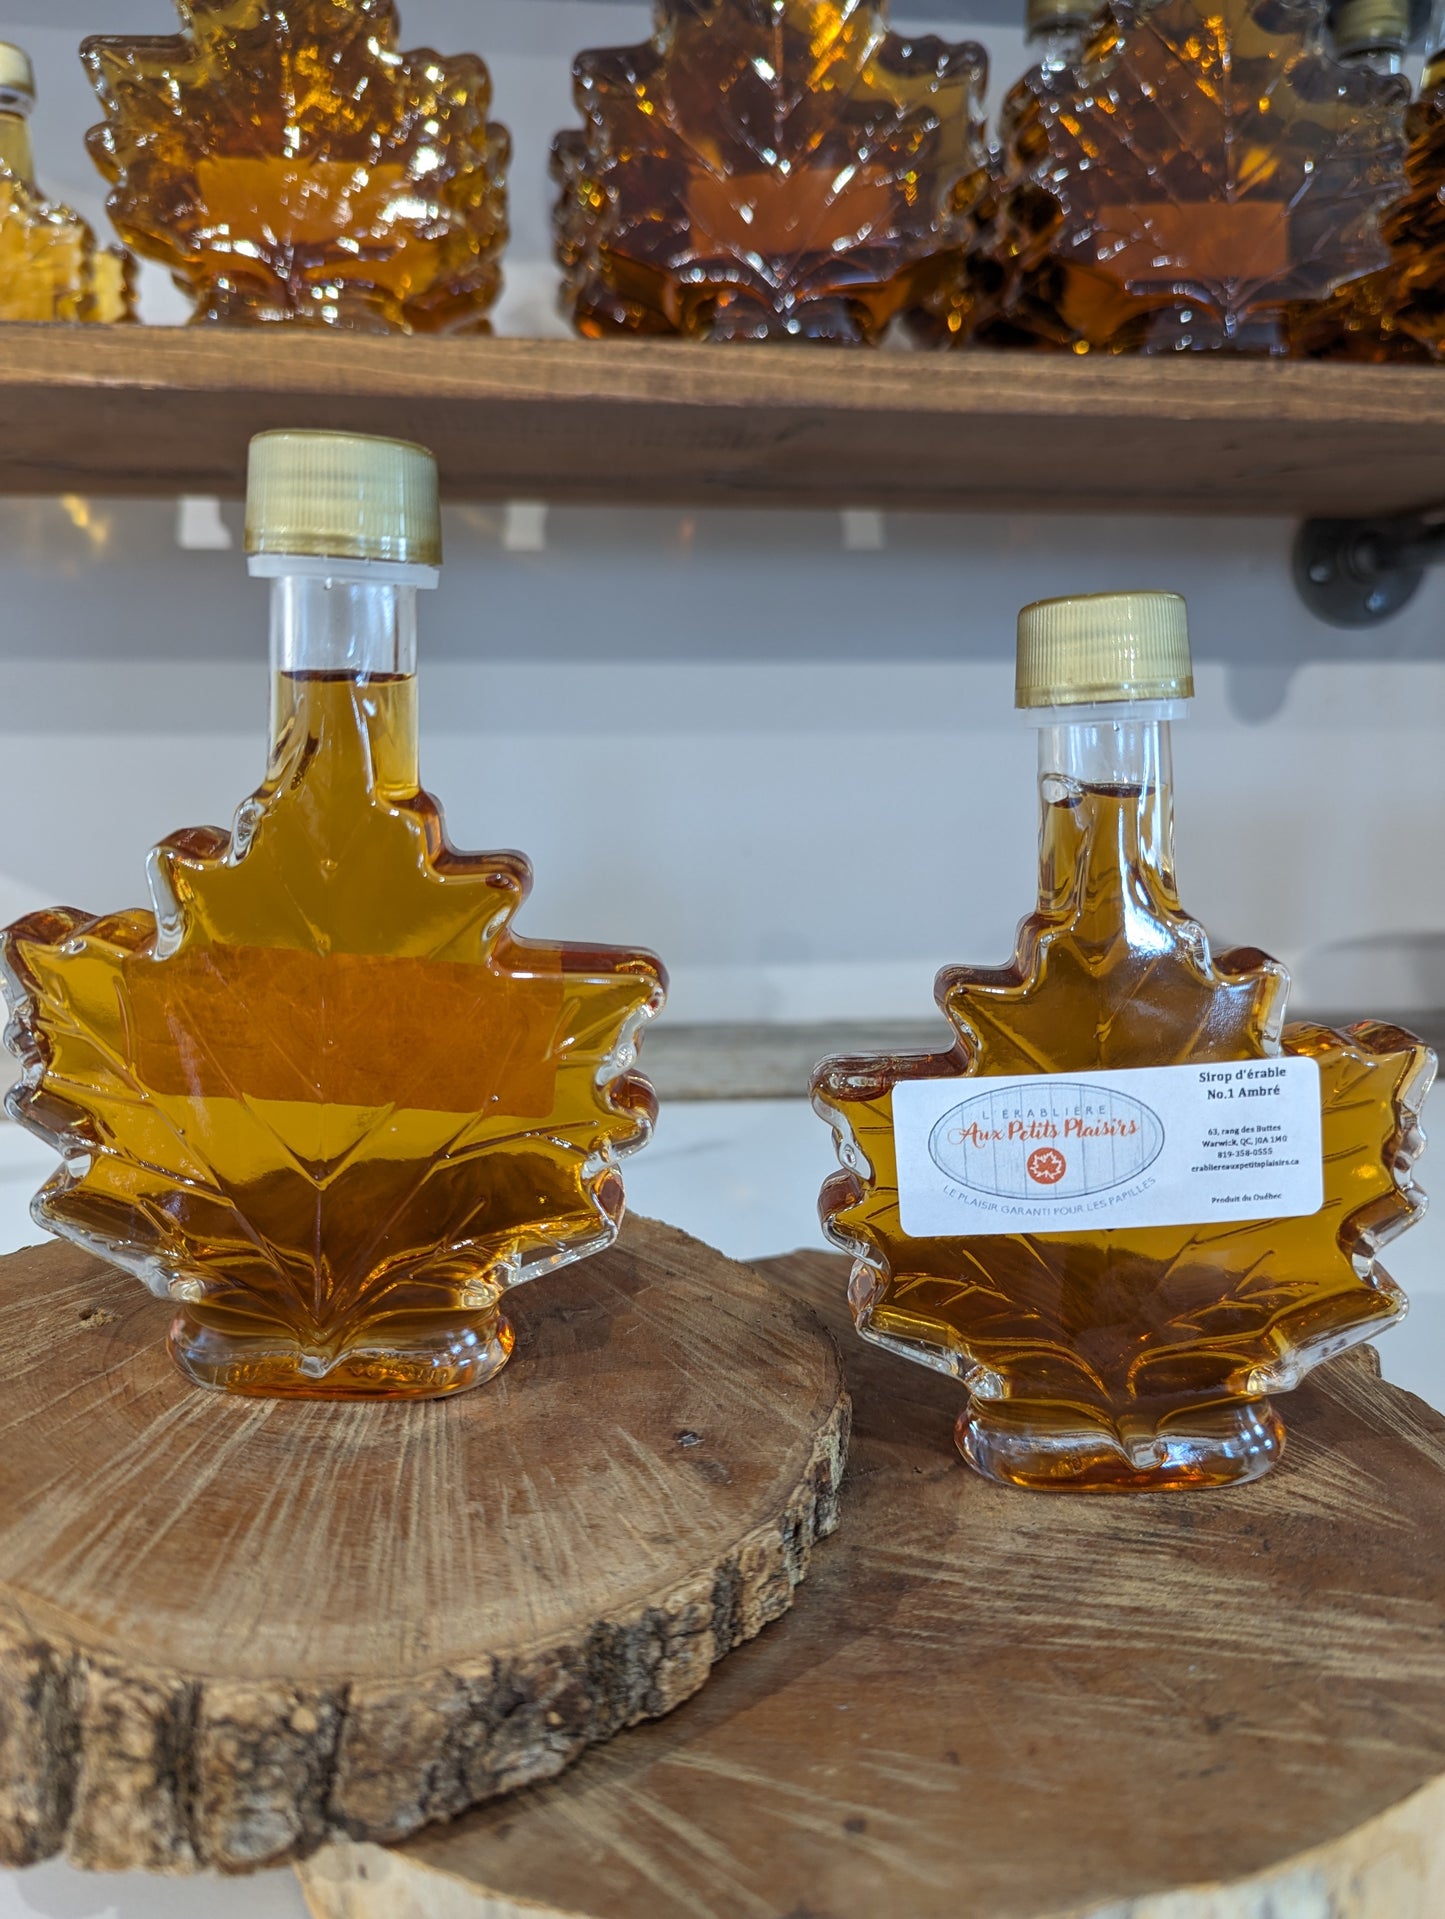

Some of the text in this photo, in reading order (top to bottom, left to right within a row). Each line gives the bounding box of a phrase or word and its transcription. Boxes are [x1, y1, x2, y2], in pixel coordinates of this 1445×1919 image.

[1199, 1066, 1287, 1084] Sirop d'érable
[1207, 1084, 1280, 1100] No.1 Ambré
[947, 1117, 1138, 1148] Aux Petits Plaisirs
[1221, 1128, 1239, 1136] rang
[1241, 1125, 1255, 1133] des
[958, 1192, 998, 1212] PLAISIR
[1001, 1206, 1050, 1216] GARANTI
[1053, 1204, 1084, 1216] POUR
[1086, 1199, 1107, 1212] LES
[1108, 1176, 1156, 1205] PAPILLES
